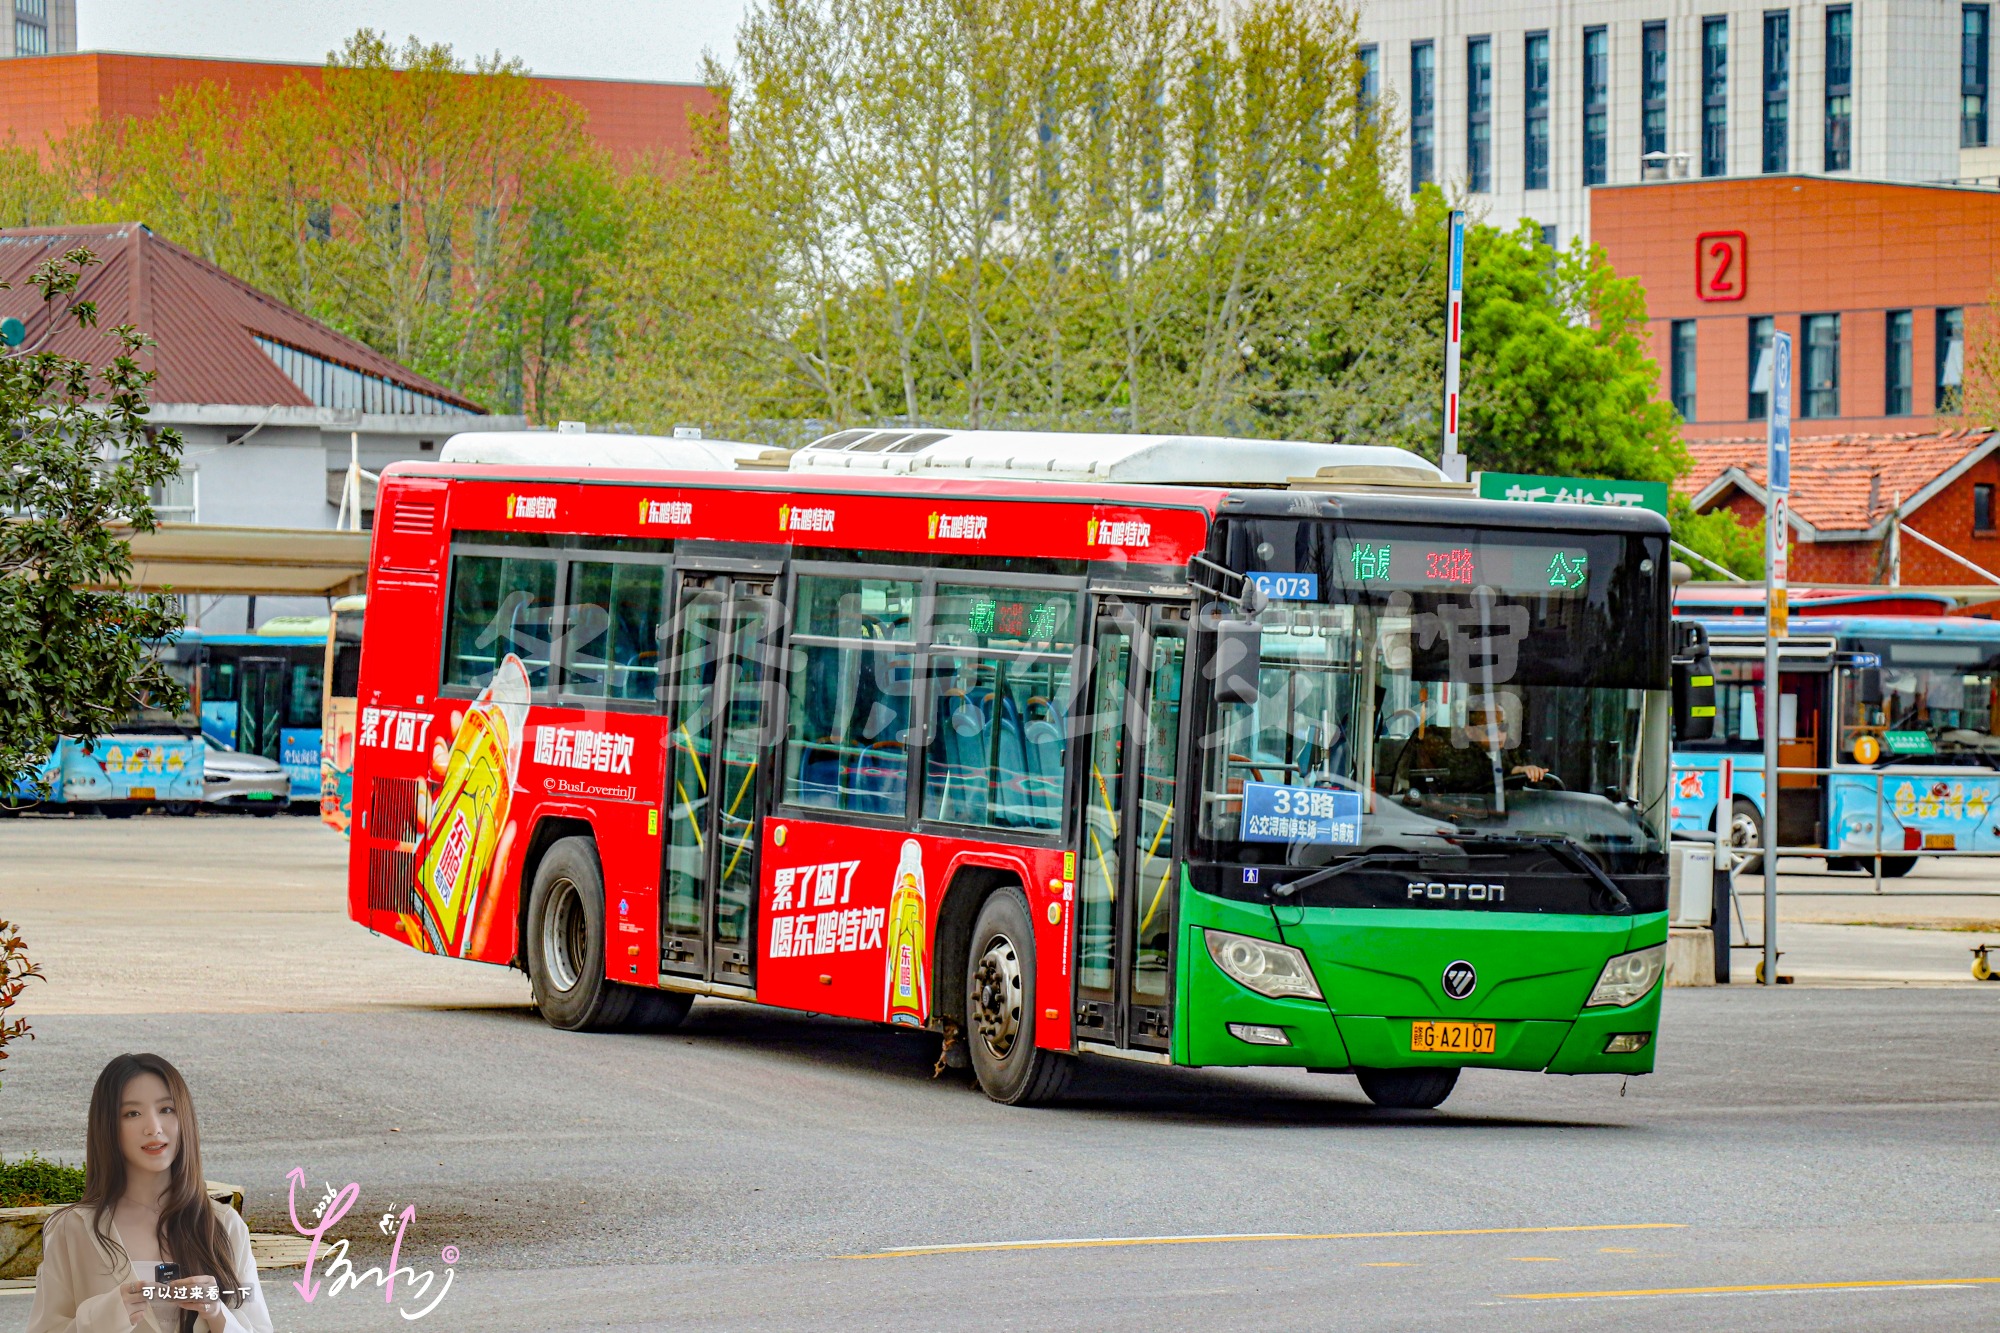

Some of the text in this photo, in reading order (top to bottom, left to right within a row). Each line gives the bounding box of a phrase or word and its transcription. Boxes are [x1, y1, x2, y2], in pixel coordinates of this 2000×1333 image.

[1709, 242, 1733, 291] 2
[516, 495, 557, 519] 东鹏特饮
[648, 500, 692, 525] 东鹏特饮
[790, 507, 836, 532] 东鹏特饮
[939, 513, 988, 540] 东鹏特饮
[1098, 520, 1151, 547] 东鹏特饮
[1426, 548, 1476, 585] 33路
[1256, 576, 1310, 597] C 073
[359, 707, 435, 752] 累了困了
[533, 725, 635, 775] 喝东鹏特饮
[1273, 789, 1335, 819] 33路
[771, 859, 861, 911] 累了困了
[1407, 882, 1505, 901] FOTON
[769, 905, 886, 959] 喝东鹏特饮
